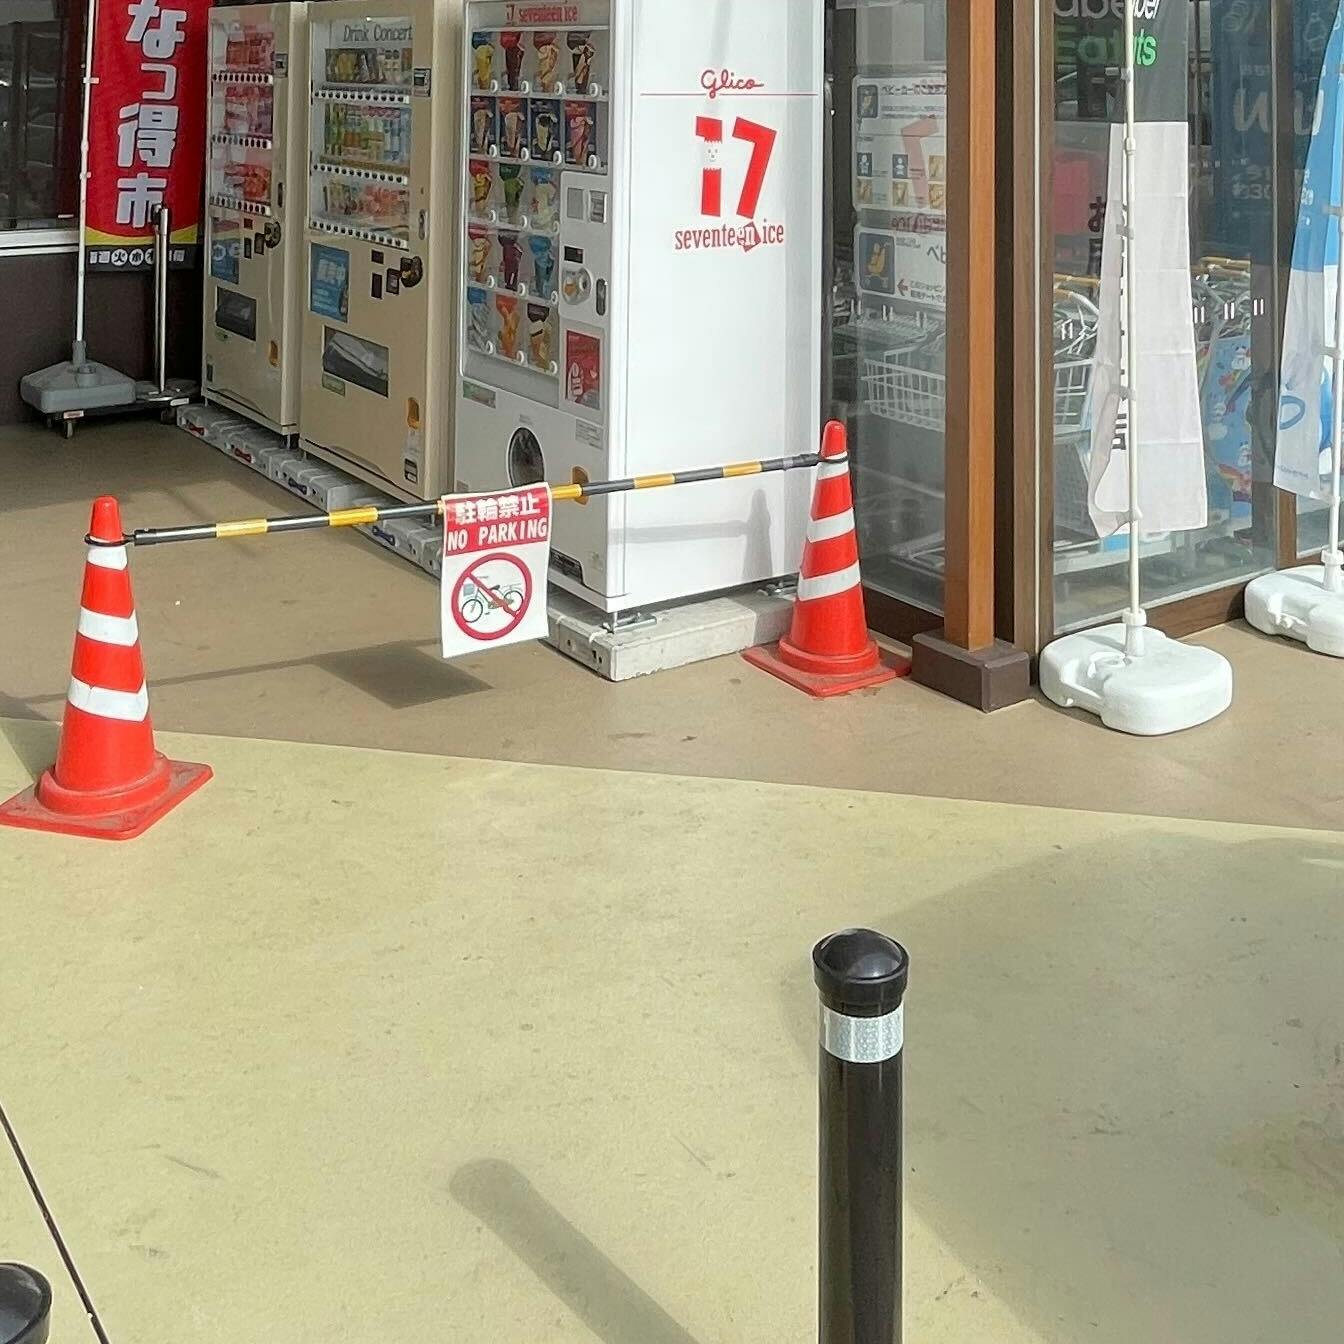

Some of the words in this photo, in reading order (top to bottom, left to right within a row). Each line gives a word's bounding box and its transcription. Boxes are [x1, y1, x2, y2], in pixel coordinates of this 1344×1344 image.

[343, 24, 369, 42] Drink
[373, 24, 413, 42] Concert
[701, 69, 765, 99] Glico
[674, 222, 760, 251] seventeen
[762, 218, 785, 244] ice
[455, 492, 541, 525] 駐輪禁止
[448, 529, 469, 552] NO
[478, 517, 547, 547] PARKING
